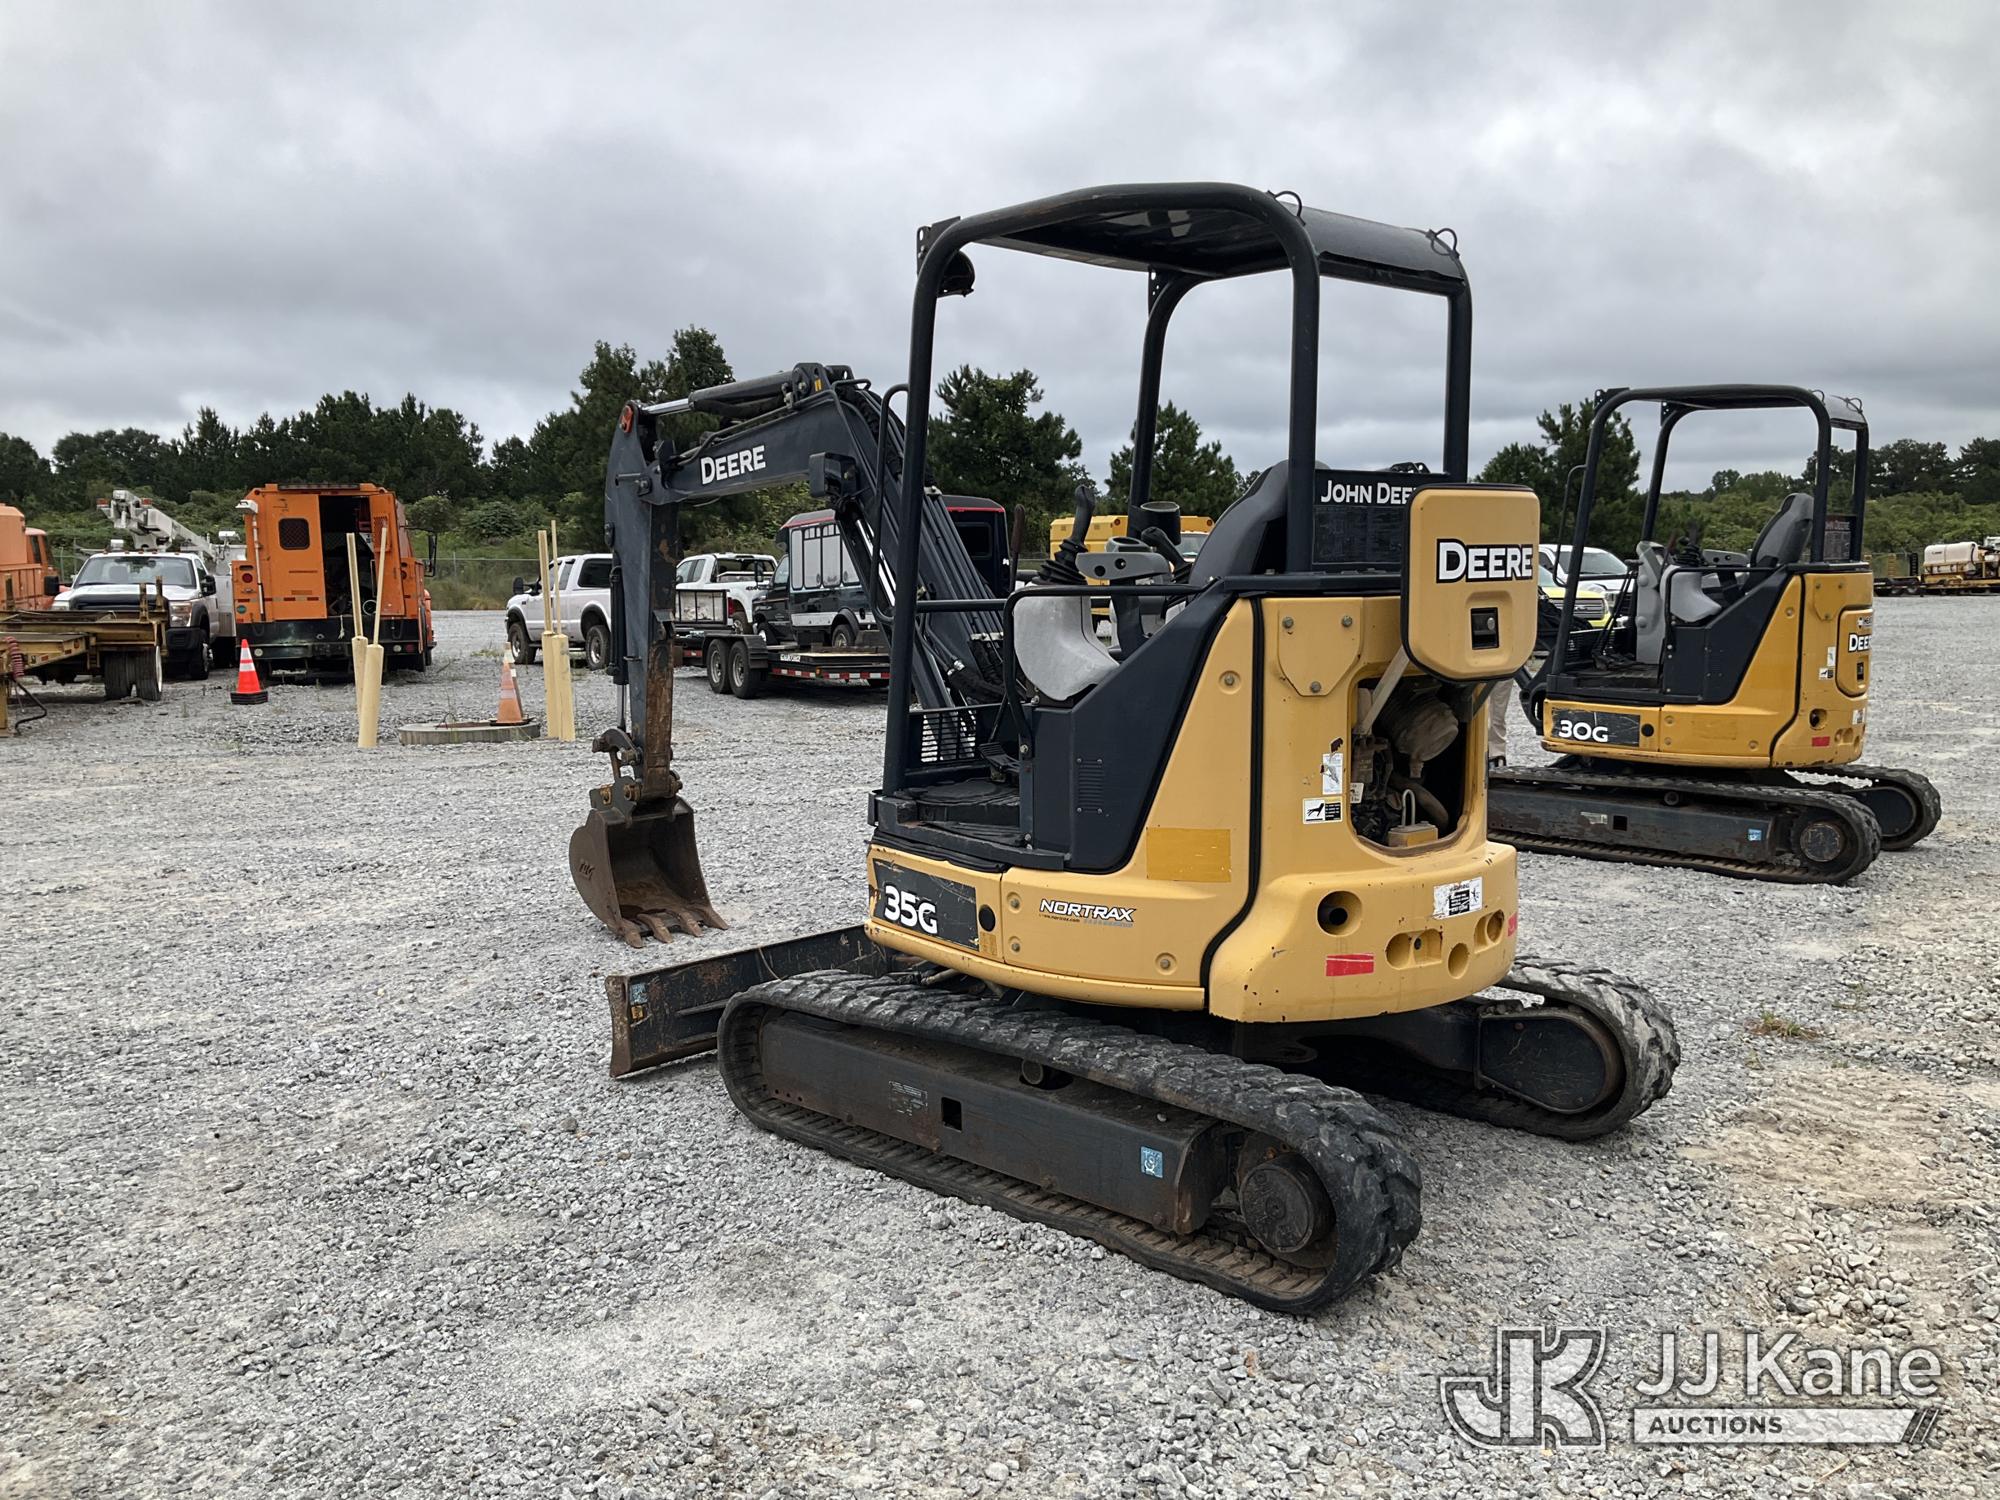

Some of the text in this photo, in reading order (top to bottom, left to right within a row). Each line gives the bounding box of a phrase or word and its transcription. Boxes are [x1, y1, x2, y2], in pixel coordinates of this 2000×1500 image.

[700, 445, 766, 485] DEERE
[1320, 480, 1417, 505] JOHN DEE
[1437, 539, 1533, 582] DEERE
[1849, 632, 1872, 652] DEE
[1558, 719, 1609, 743] 30G
[884, 885, 938, 935] 35G
[1040, 898, 1136, 923] NORTRAX
